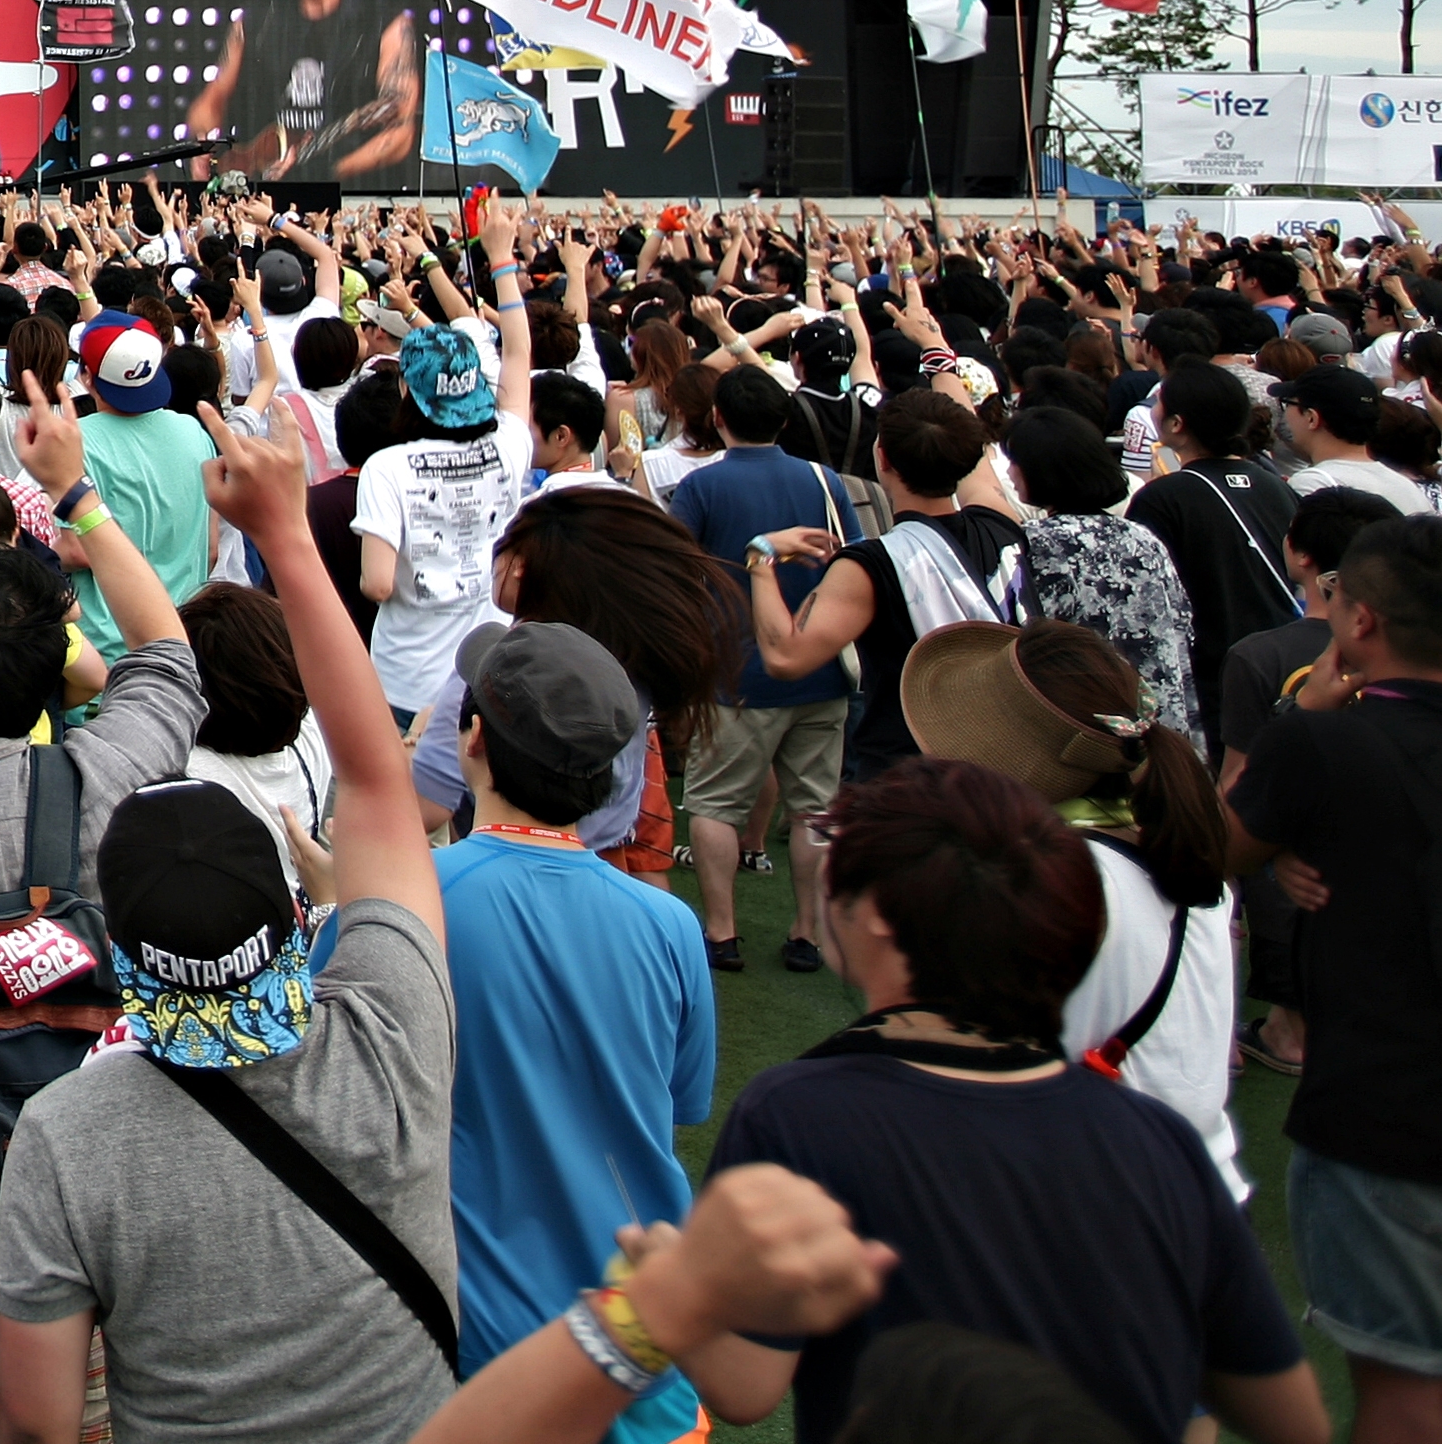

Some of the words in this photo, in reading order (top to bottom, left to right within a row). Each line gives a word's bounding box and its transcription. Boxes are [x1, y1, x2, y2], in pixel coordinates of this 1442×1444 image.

[1213, 89, 1270, 117] ifez
[1239, 160, 1265, 168] ROCK
[140, 923, 270, 988] PENTAPORT
